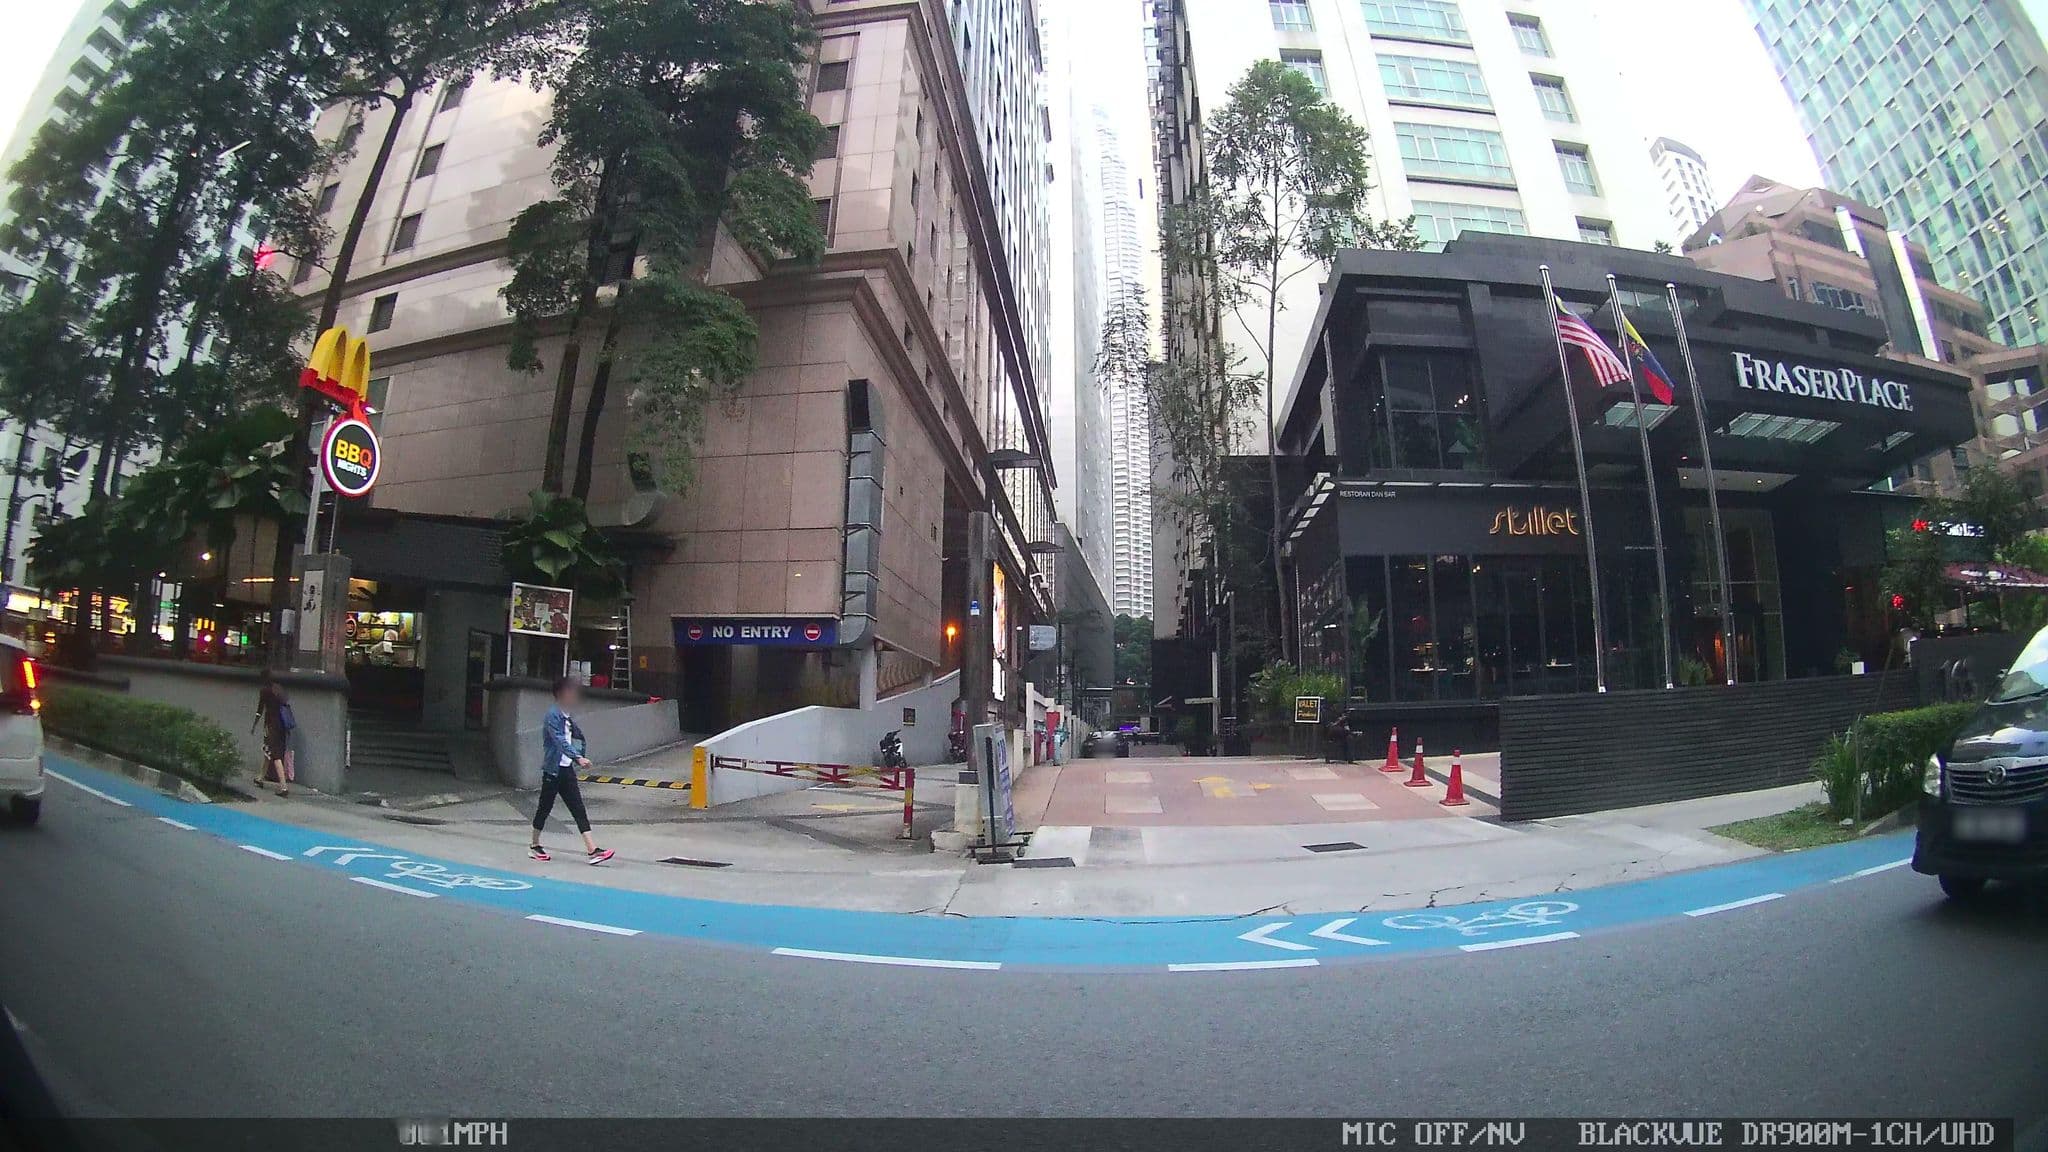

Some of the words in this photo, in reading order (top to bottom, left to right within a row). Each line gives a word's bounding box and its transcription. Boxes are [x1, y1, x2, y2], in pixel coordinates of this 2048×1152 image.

[335, 439, 373, 469] BBQ
[712, 625, 735, 639] NO
[741, 625, 793, 639] ENTRY
